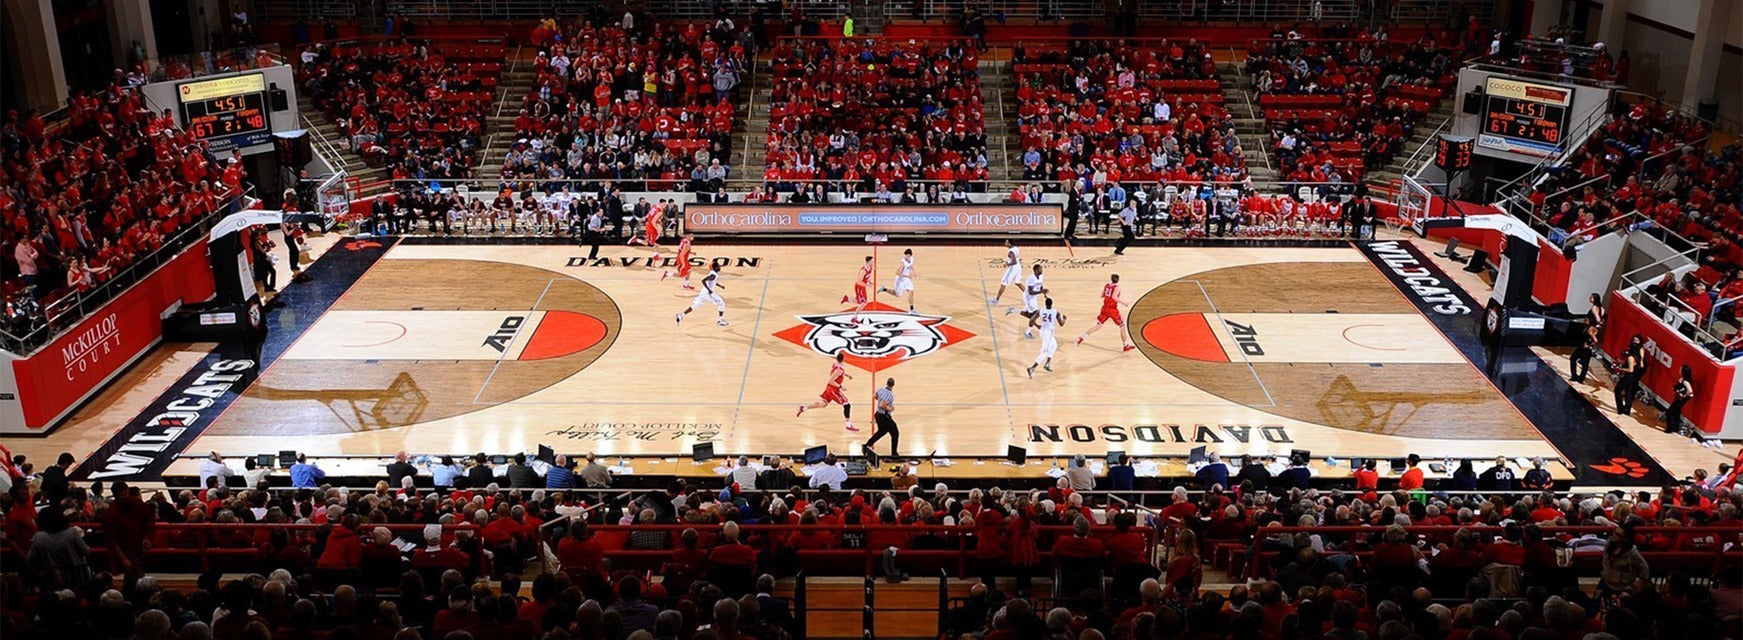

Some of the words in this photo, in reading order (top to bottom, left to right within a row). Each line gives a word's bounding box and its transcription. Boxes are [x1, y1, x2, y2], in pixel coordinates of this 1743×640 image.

[1489, 81, 1522, 93] COCOCO
[195, 122, 214, 137] 67
[224, 121, 232, 131] 2
[246, 114, 264, 128] 48
[1490, 119, 1508, 133] 67
[1518, 125, 1526, 136] 2
[1541, 127, 1559, 142] 48
[1455, 151, 1471, 168] 33
[1367, 240, 1472, 315] WILDCATS
[1042, 313, 1052, 323] 24
[66, 332, 122, 382] COURT
[86, 359, 256, 480] WILDCATS
[1027, 423, 1294, 443] DAVIDSON
[850, 539, 860, 547] 11
